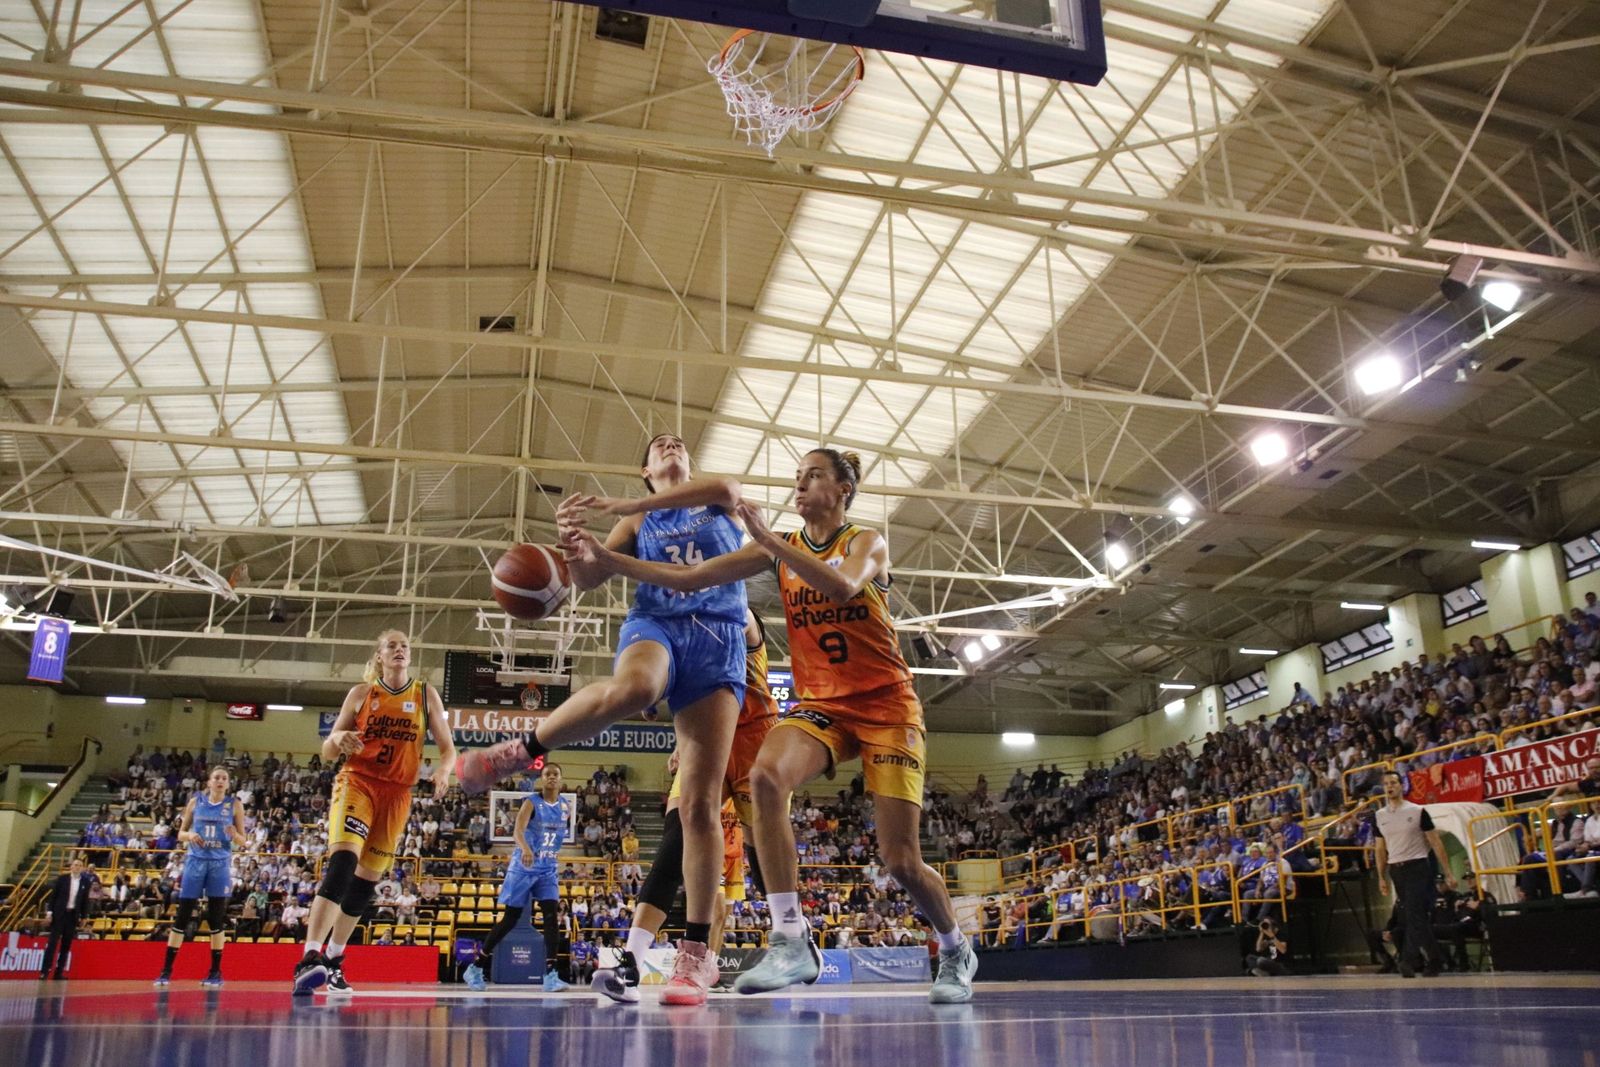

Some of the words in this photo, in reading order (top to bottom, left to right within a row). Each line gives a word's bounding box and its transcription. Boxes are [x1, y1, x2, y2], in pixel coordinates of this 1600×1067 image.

[665, 541, 704, 566] 34
[785, 586, 830, 607] ultu
[791, 605, 869, 629] sfuerzo
[44, 632, 58, 654] 8
[818, 631, 848, 664] 9
[771, 687, 790, 700] 55
[366, 714, 412, 728] Cultura
[453, 709, 480, 730] LA
[483, 711, 547, 731] GACET
[365, 726, 417, 742] Esfuerzo
[460, 730, 497, 743] CON
[599, 730, 620, 747] DE
[624, 731, 677, 749] EUROP
[376, 744, 395, 765] 21
[873, 754, 919, 769] zummo
[1483, 734, 1600, 777] AMANCA
[1496, 776, 1517, 794] DE
[1519, 771, 1540, 789] LA
[1542, 761, 1590, 785] HUMA
[205, 825, 216, 838] 11
[542, 832, 557, 847] 32
